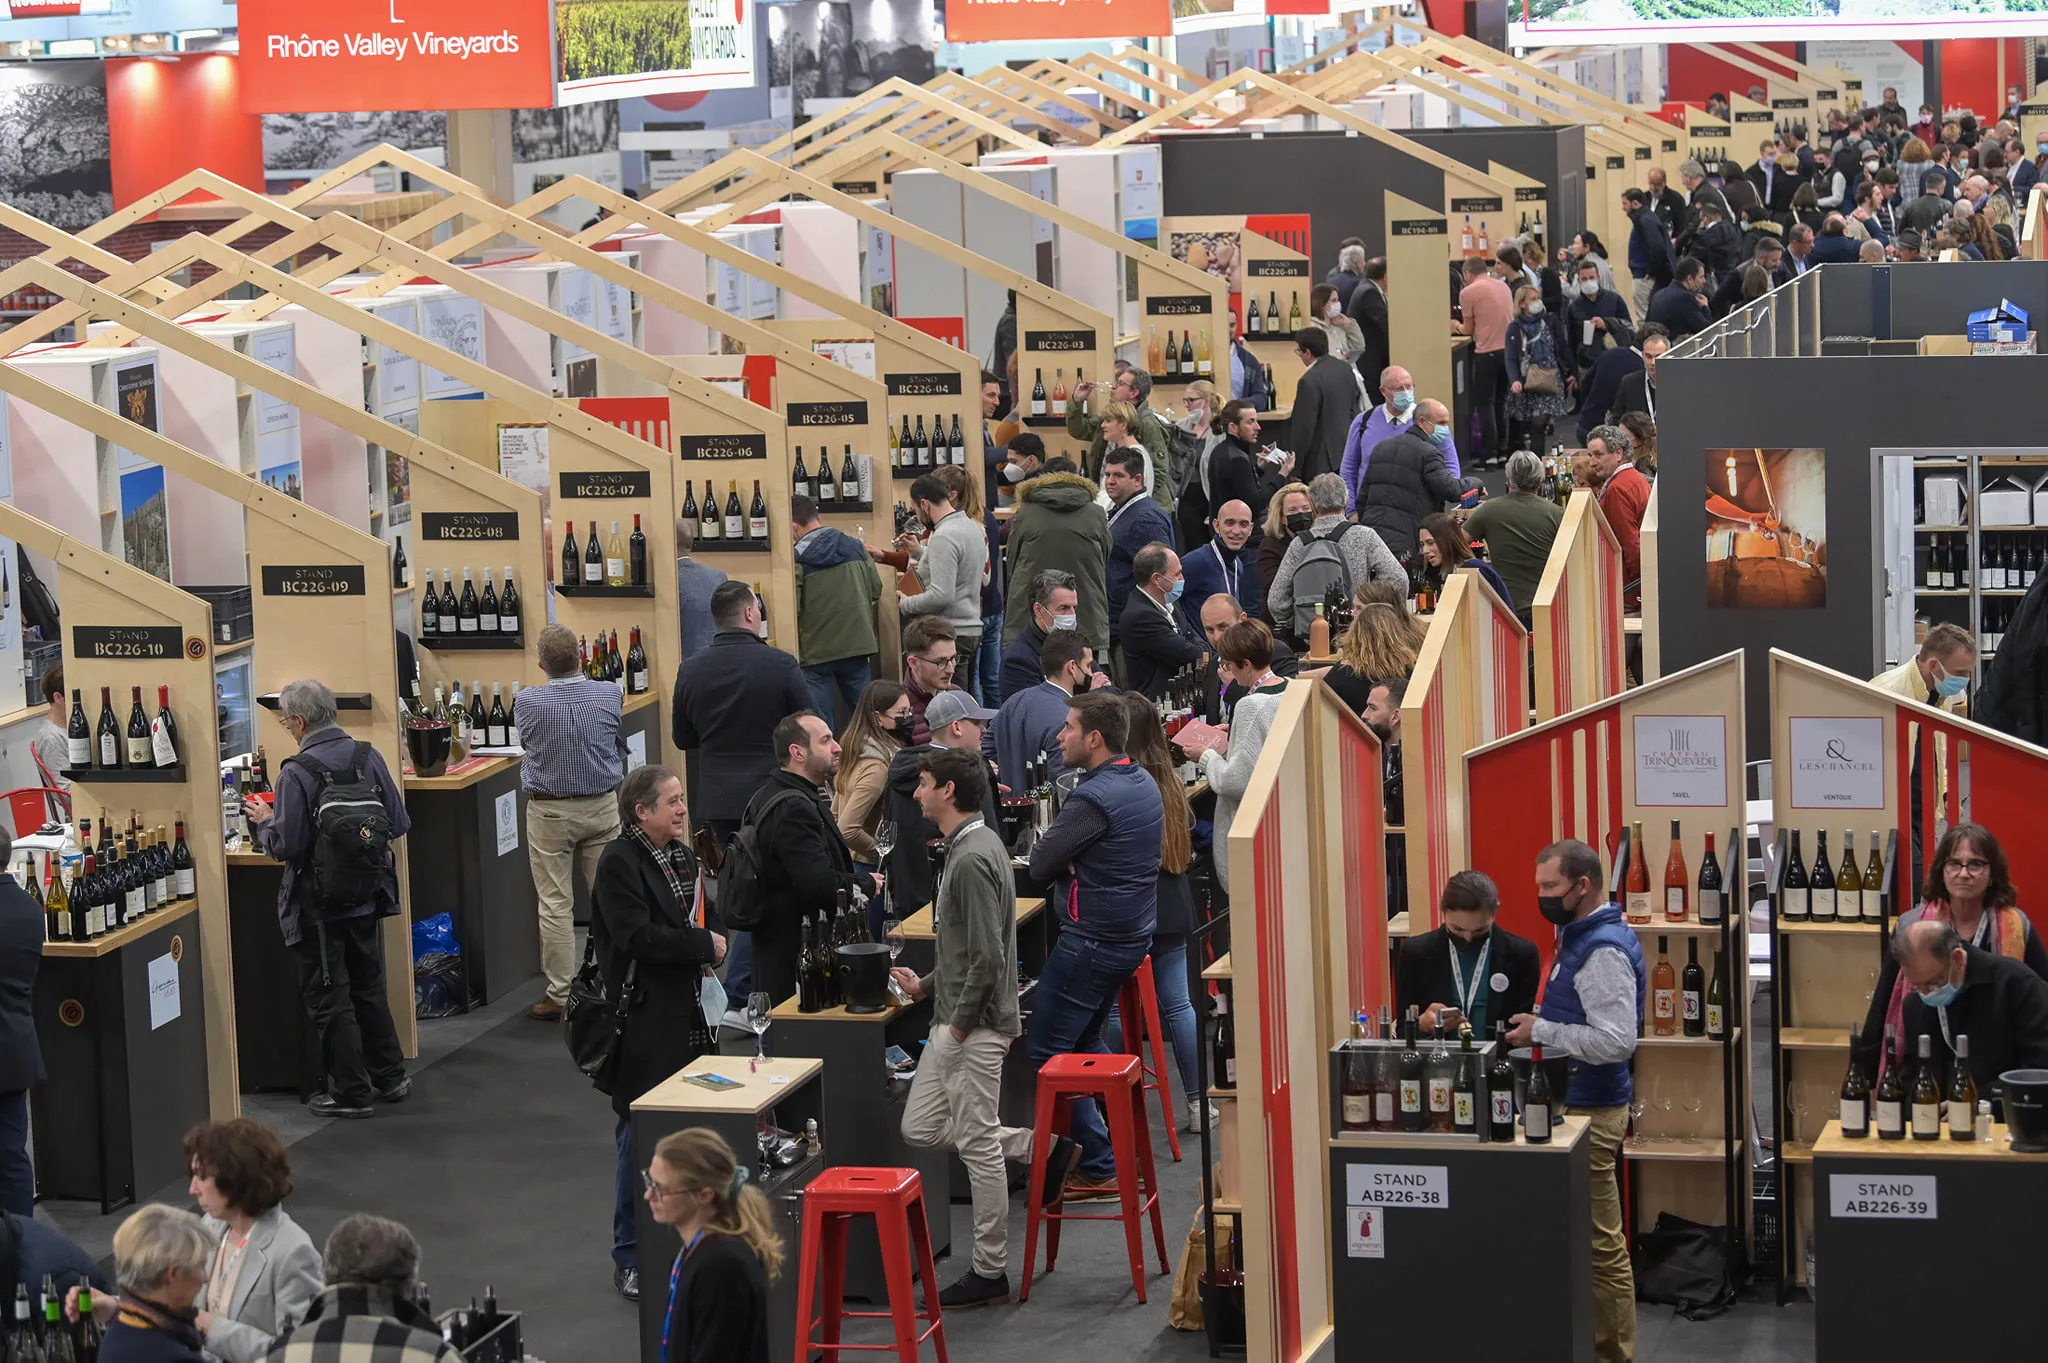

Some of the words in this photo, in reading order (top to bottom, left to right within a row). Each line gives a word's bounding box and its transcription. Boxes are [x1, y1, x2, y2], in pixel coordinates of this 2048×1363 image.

[267, 33, 339, 58] Rhône
[344, 31, 407, 61] Valley
[412, 29, 519, 61] Vineyards
[1258, 268, 1298, 276] BC226-01
[1158, 305, 1201, 314] BC226-02
[1038, 340, 1085, 351] BC226-03
[908, 375, 938, 384] STAND
[899, 384, 949, 395] BC226-04
[813, 405, 843, 413] STAND
[802, 414, 855, 425] BC226-05
[709, 438, 740, 446] STAND
[697, 447, 753, 458] BC226-06
[588, 475, 623, 484] STAND
[577, 485, 636, 497] BC226-07
[453, 515, 489, 525] STAND
[441, 526, 504, 538] BC226-08
[295, 569, 333, 579] STAND
[282, 580, 349, 593] BC226-09
[109, 630, 149, 641] STAND
[95, 643, 164, 656] BC226-10
[1642, 754, 1719, 768] TRINQUEVEDEL
[1799, 762, 1876, 771] LESCHANCEL
[1672, 791, 1690, 799] TAVEL
[1374, 1173, 1427, 1187] STAND
[1858, 1183, 1914, 1197] STAND
[1361, 1189, 1440, 1204] AB226-38
[1845, 1200, 1928, 1215] AB226-39
